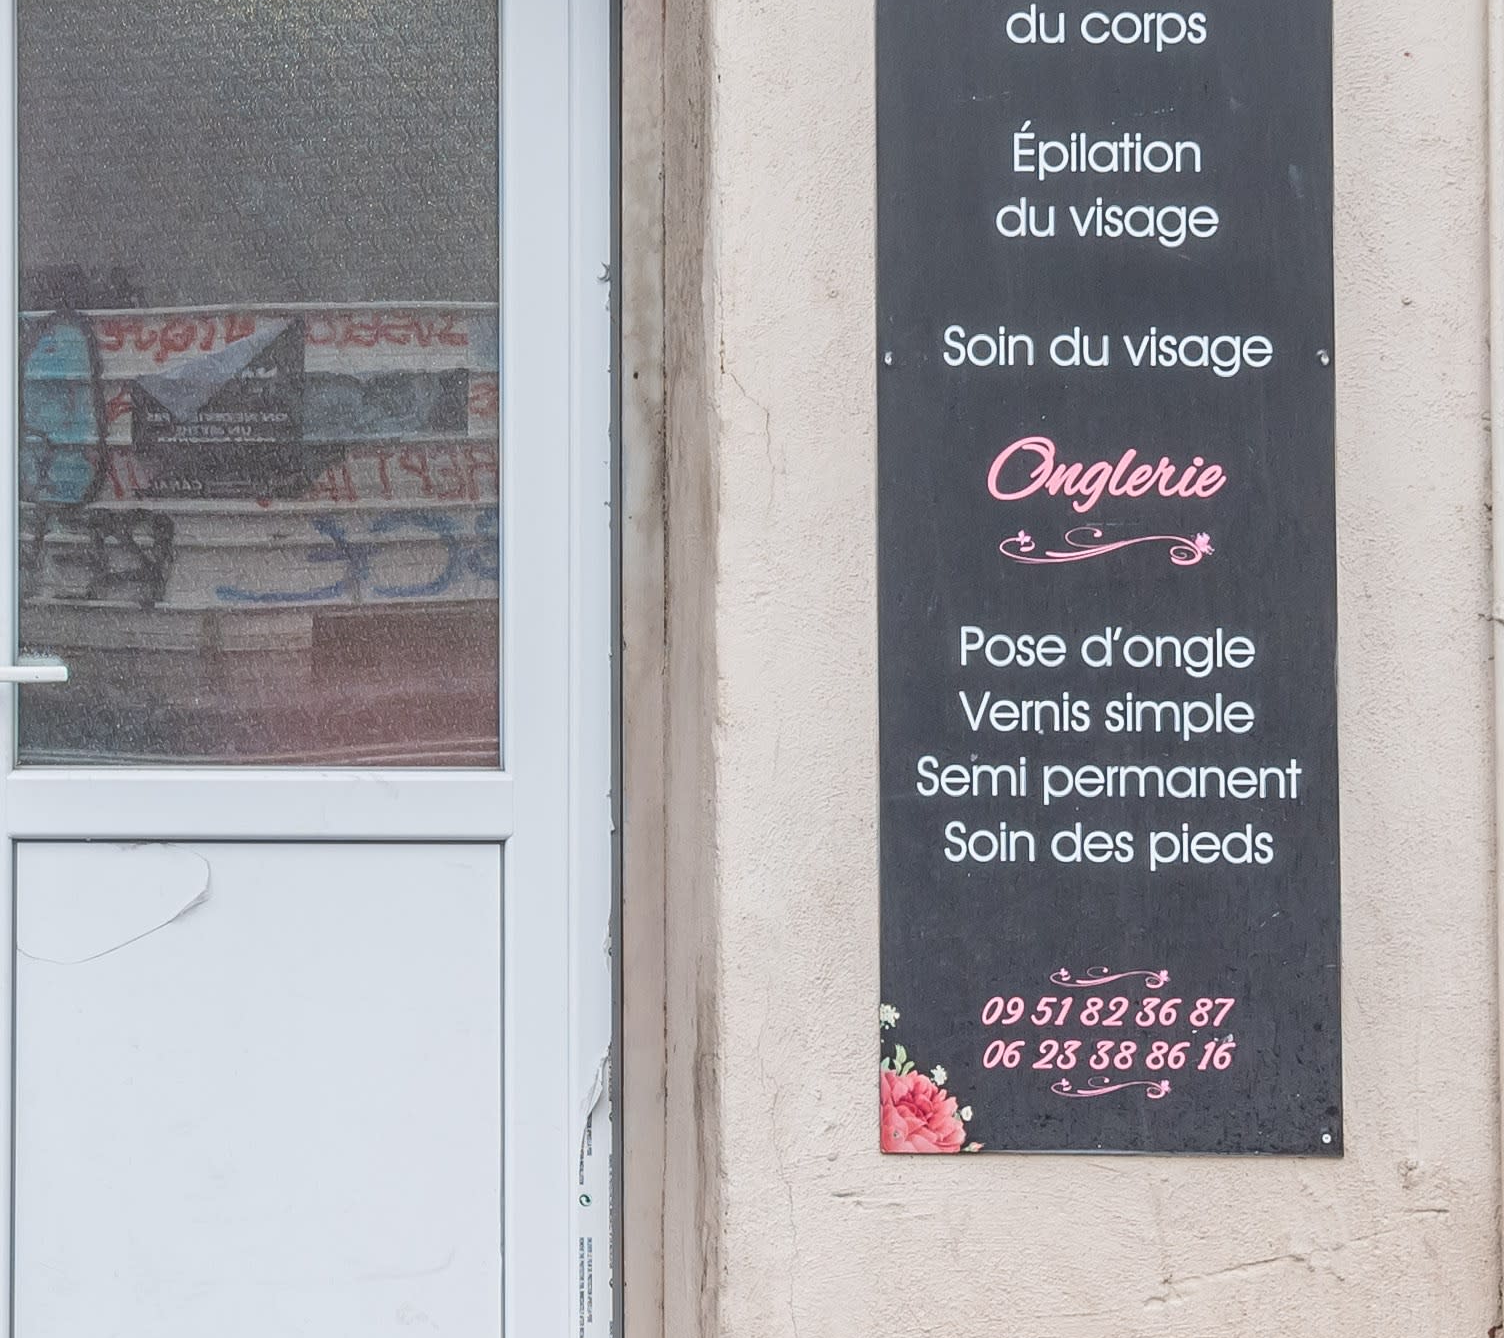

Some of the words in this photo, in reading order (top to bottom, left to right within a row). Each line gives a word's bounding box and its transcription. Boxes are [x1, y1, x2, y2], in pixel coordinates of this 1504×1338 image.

[1005, 3, 1065, 44] du
[1080, 11, 1207, 53] corps
[1013, 120, 1201, 181] Épilation
[995, 196, 1055, 238] du
[1069, 196, 1220, 248] visage
[943, 324, 1034, 367] Soin
[1049, 326, 1109, 367] du
[1122, 326, 1273, 378] visage
[987, 436, 1227, 513] Onglerie
[960, 625, 1067, 667] Pose
[958, 690, 1091, 734] Vernis
[1104, 691, 1255, 742] simple
[916, 755, 1027, 797] Semi
[1043, 758, 1303, 806] permanent
[944, 820, 1036, 863] Soin
[1050, 821, 1134, 863] des
[1149, 822, 1274, 872] pieds
[981, 996, 1025, 1025] 09
[1030, 996, 1073, 1026] 51
[1079, 996, 1128, 1026] 82
[1135, 997, 1183, 1027] 36
[1189, 997, 1235, 1027] 87
[982, 1039, 1026, 1069] 06
[1032, 1039, 1082, 1070] 23
[1089, 1040, 1137, 1070] 38
[1145, 1041, 1191, 1070] 86
[1197, 1036, 1237, 1070] 16
